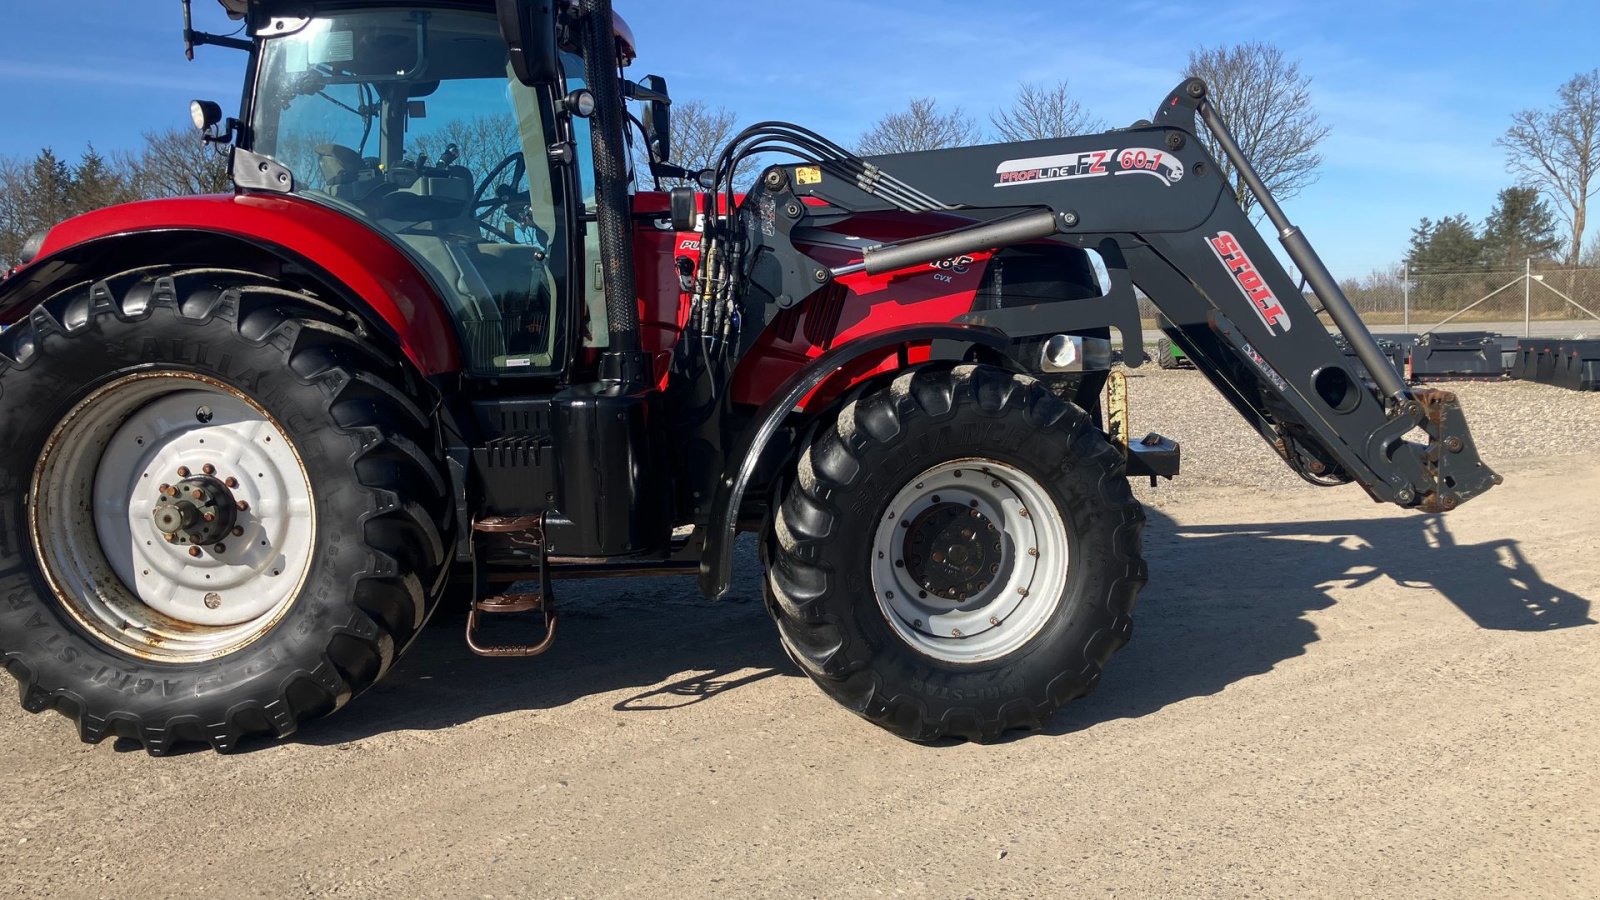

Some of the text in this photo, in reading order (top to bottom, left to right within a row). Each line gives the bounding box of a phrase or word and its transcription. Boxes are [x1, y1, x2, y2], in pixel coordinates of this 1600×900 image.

[1000, 151, 1163, 183] PROFILINE FZ 60.1
[680, 240, 700, 250] PU
[933, 273, 953, 283] CVX
[1211, 234, 1284, 326] STOLL
[139, 337, 326, 456] ALLIANCE
[8, 588, 181, 697] AGRI-STAR
